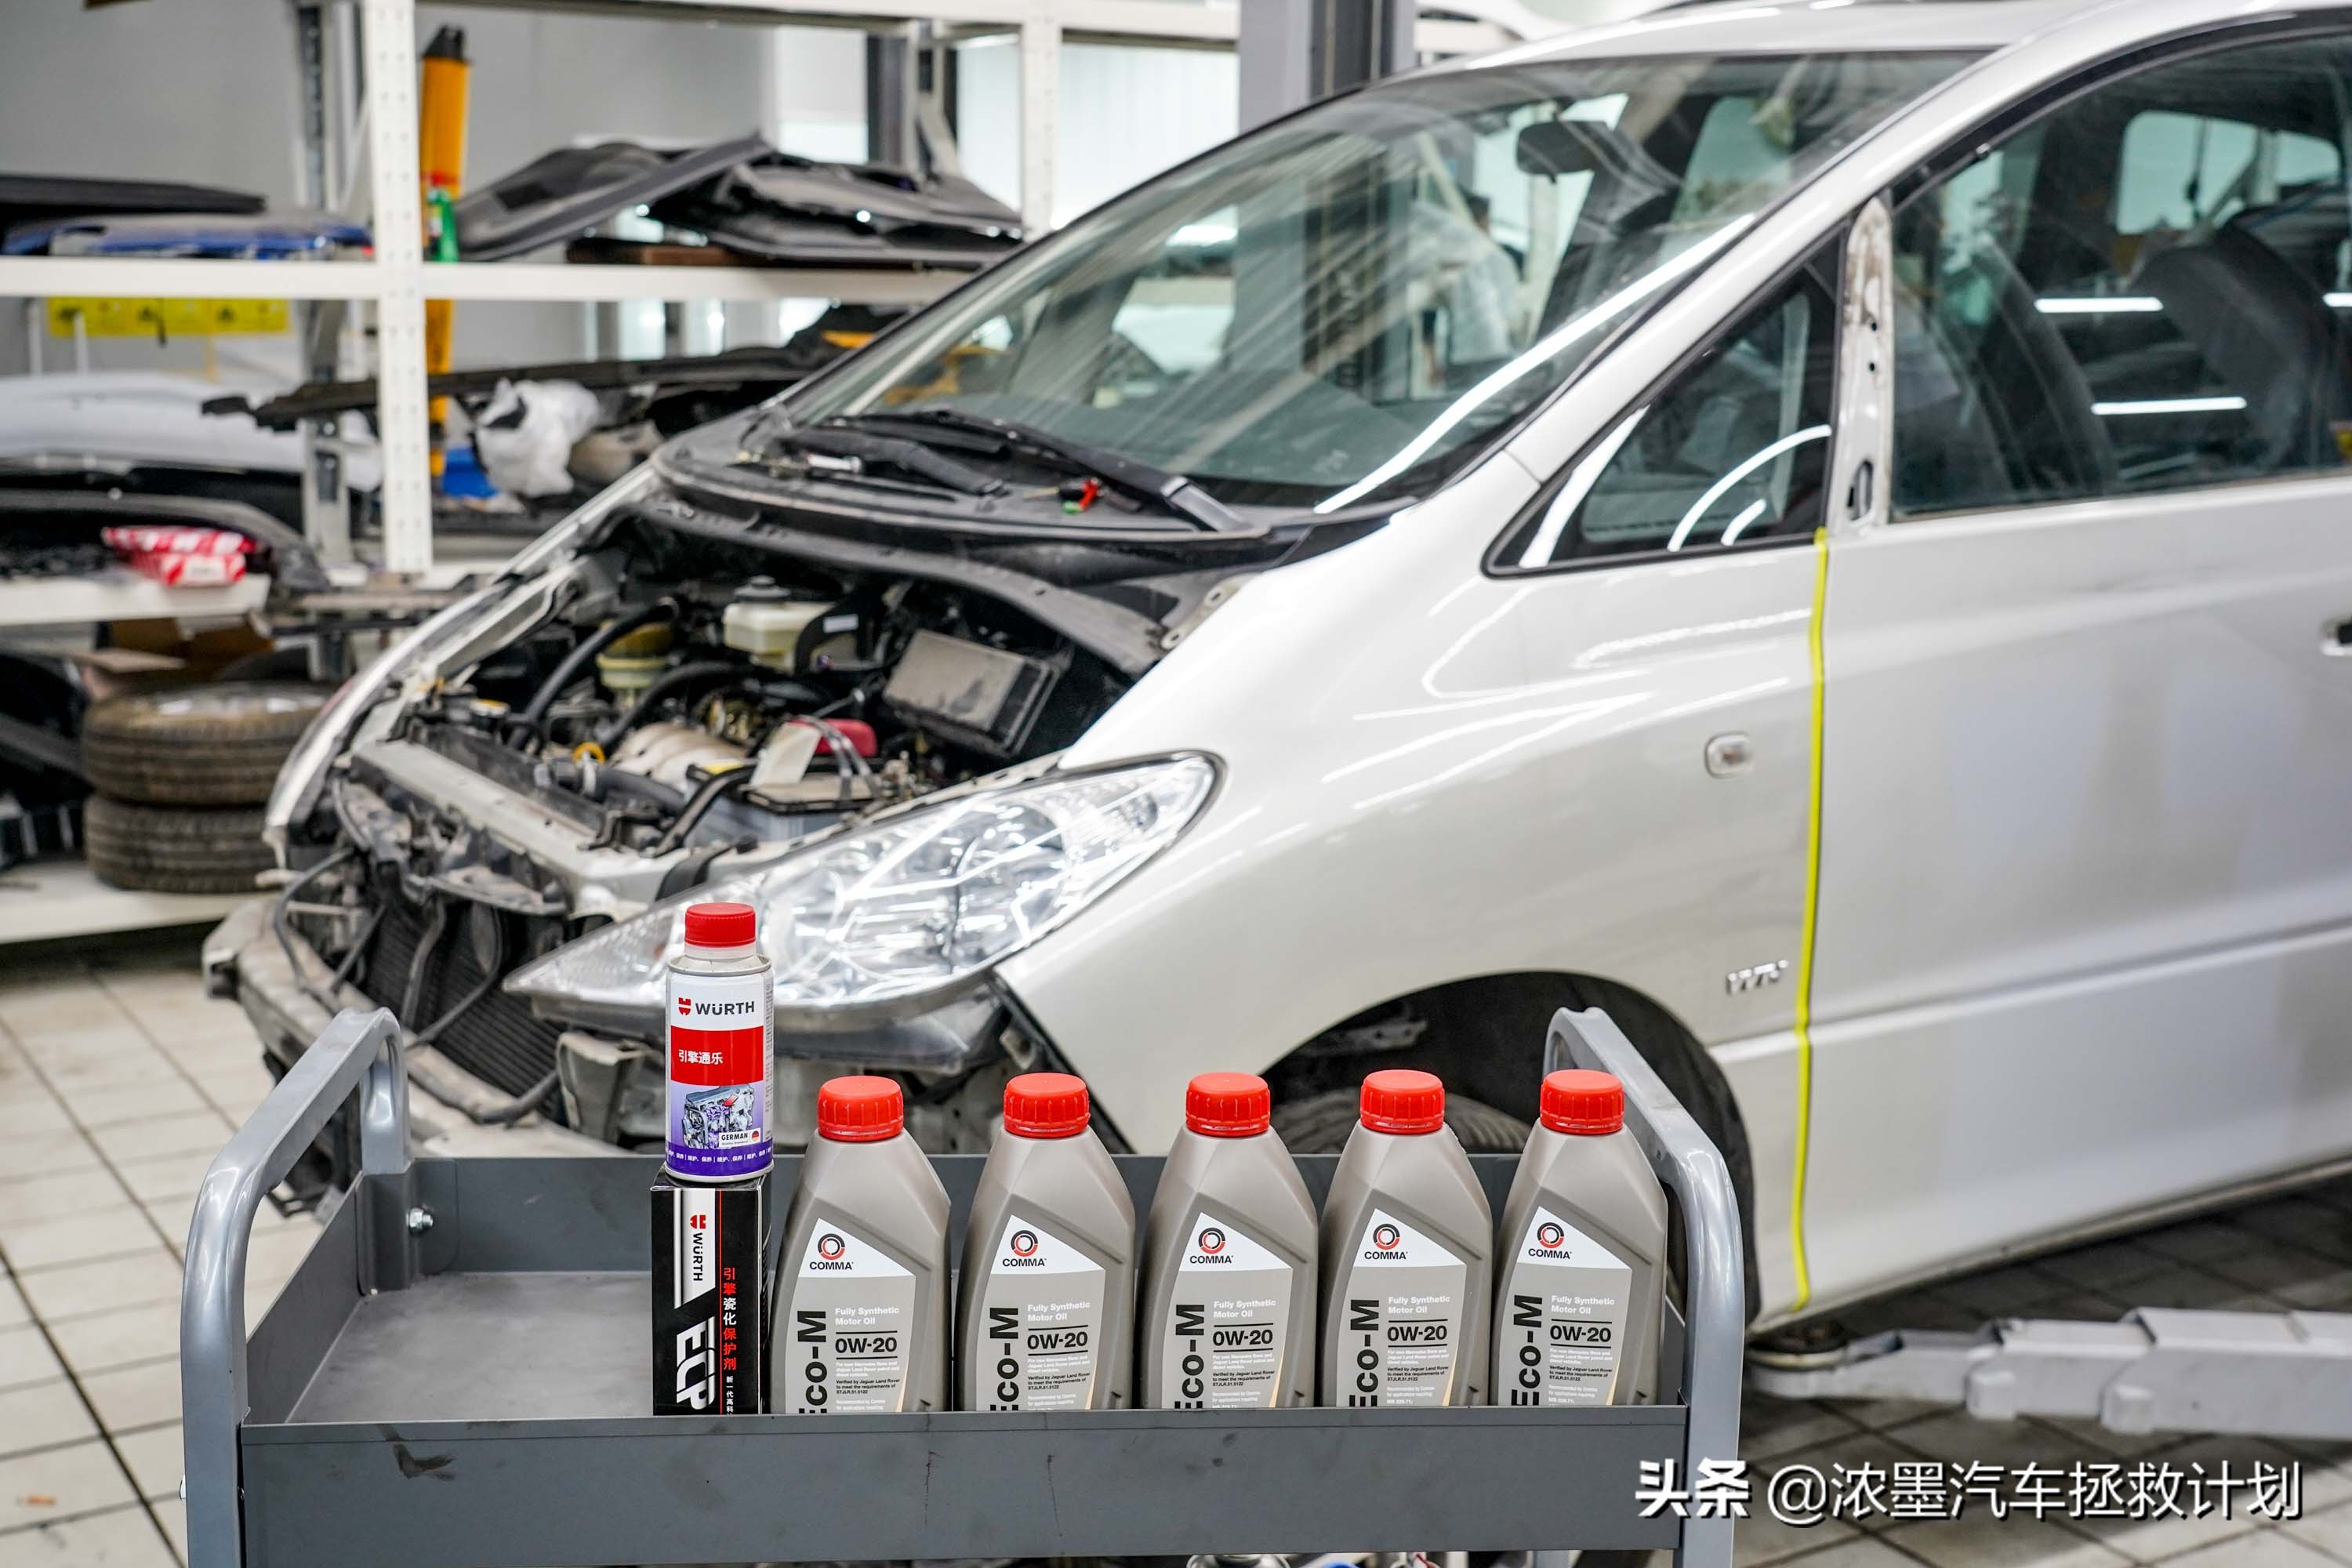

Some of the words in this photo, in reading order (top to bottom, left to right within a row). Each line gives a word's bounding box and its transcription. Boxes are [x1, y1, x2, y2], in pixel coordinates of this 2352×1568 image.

[695, 1001, 755, 1015] WÜRTH
[678, 1050, 723, 1065] 引擎通乐
[693, 1232, 703, 1281] WÜRTH
[1364, 1251, 1406, 1260] COMMA
[1528, 1248, 1570, 1259] COMMA
[1003, 1258, 1045, 1267] COMMA
[1189, 1255, 1232, 1264] COMMA
[810, 1261, 852, 1270] COMMA
[1214, 1301, 1234, 1309] Fully
[1236, 1300, 1276, 1308] Synthetic
[1388, 1297, 1409, 1305] Fully
[1411, 1296, 1450, 1305] Synthetic
[1552, 1295, 1571, 1305] Fully
[1574, 1297, 1614, 1306] Synthetic
[835, 1308, 855, 1316] Fully
[858, 1307, 899, 1316] Synthetic
[1028, 1304, 1048, 1313] Fully
[1051, 1301, 1090, 1311] Synthetic
[1552, 1305, 1577, 1314] Motor
[723, 1267, 736, 1370] 引擎瓷化保护剂
[835, 1317, 862, 1326] Motor
[1213, 1330, 1273, 1346] 0W-20
[1388, 1326, 1447, 1341] 0W-20
[1550, 1326, 1611, 1342] 0W-20
[835, 1337, 897, 1353] 0W-20
[1028, 1331, 1088, 1350] 0W-20
[677, 1316, 715, 1410] ECP
